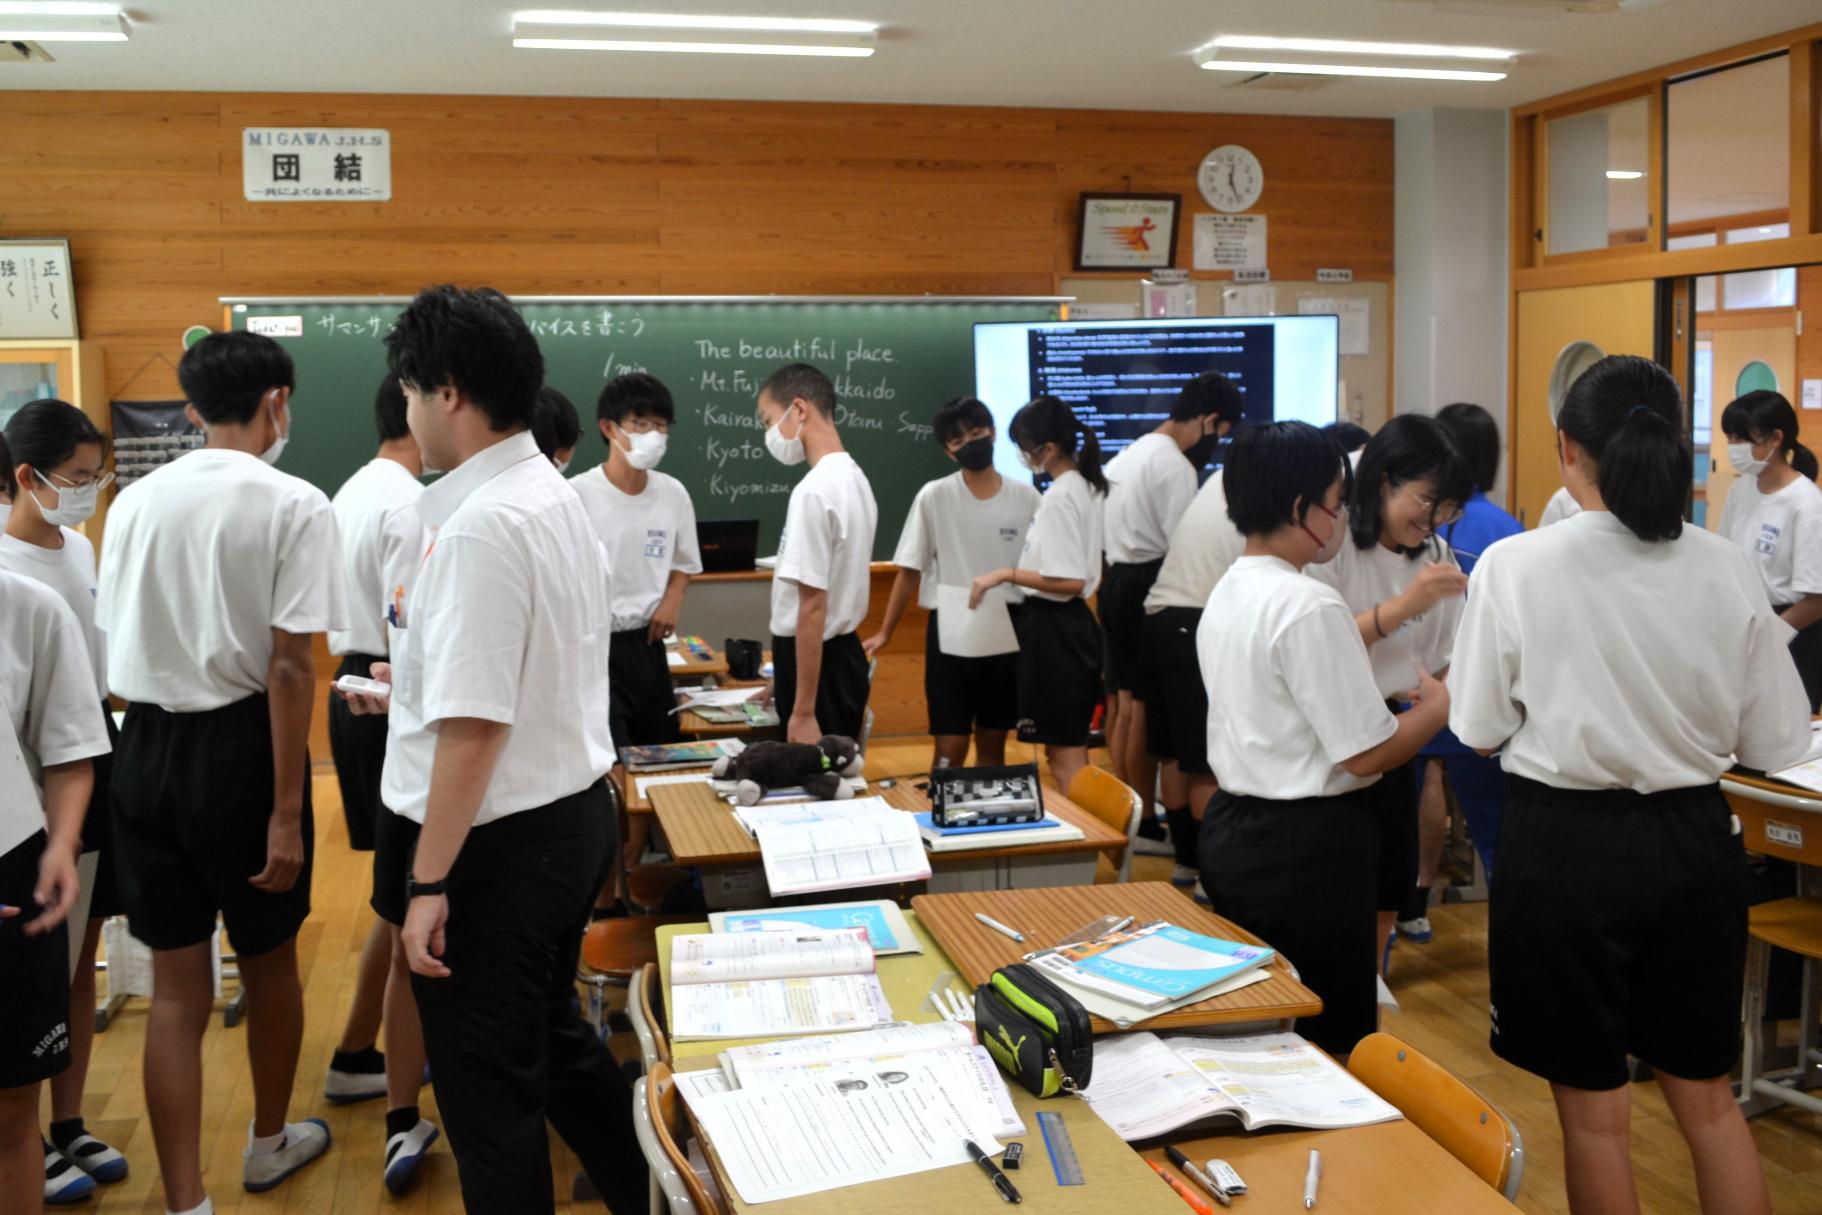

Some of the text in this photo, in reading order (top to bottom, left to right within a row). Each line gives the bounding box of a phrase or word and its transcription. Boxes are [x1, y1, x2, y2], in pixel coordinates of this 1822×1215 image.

[249, 132, 330, 146] MIGAWA
[42, 260, 60, 320] 正しく
[694, 340, 732, 360] The
[738, 336, 836, 361] beautiful
[706, 436, 764, 468] Kyoto
[710, 473, 790, 505] Kiyomizu
